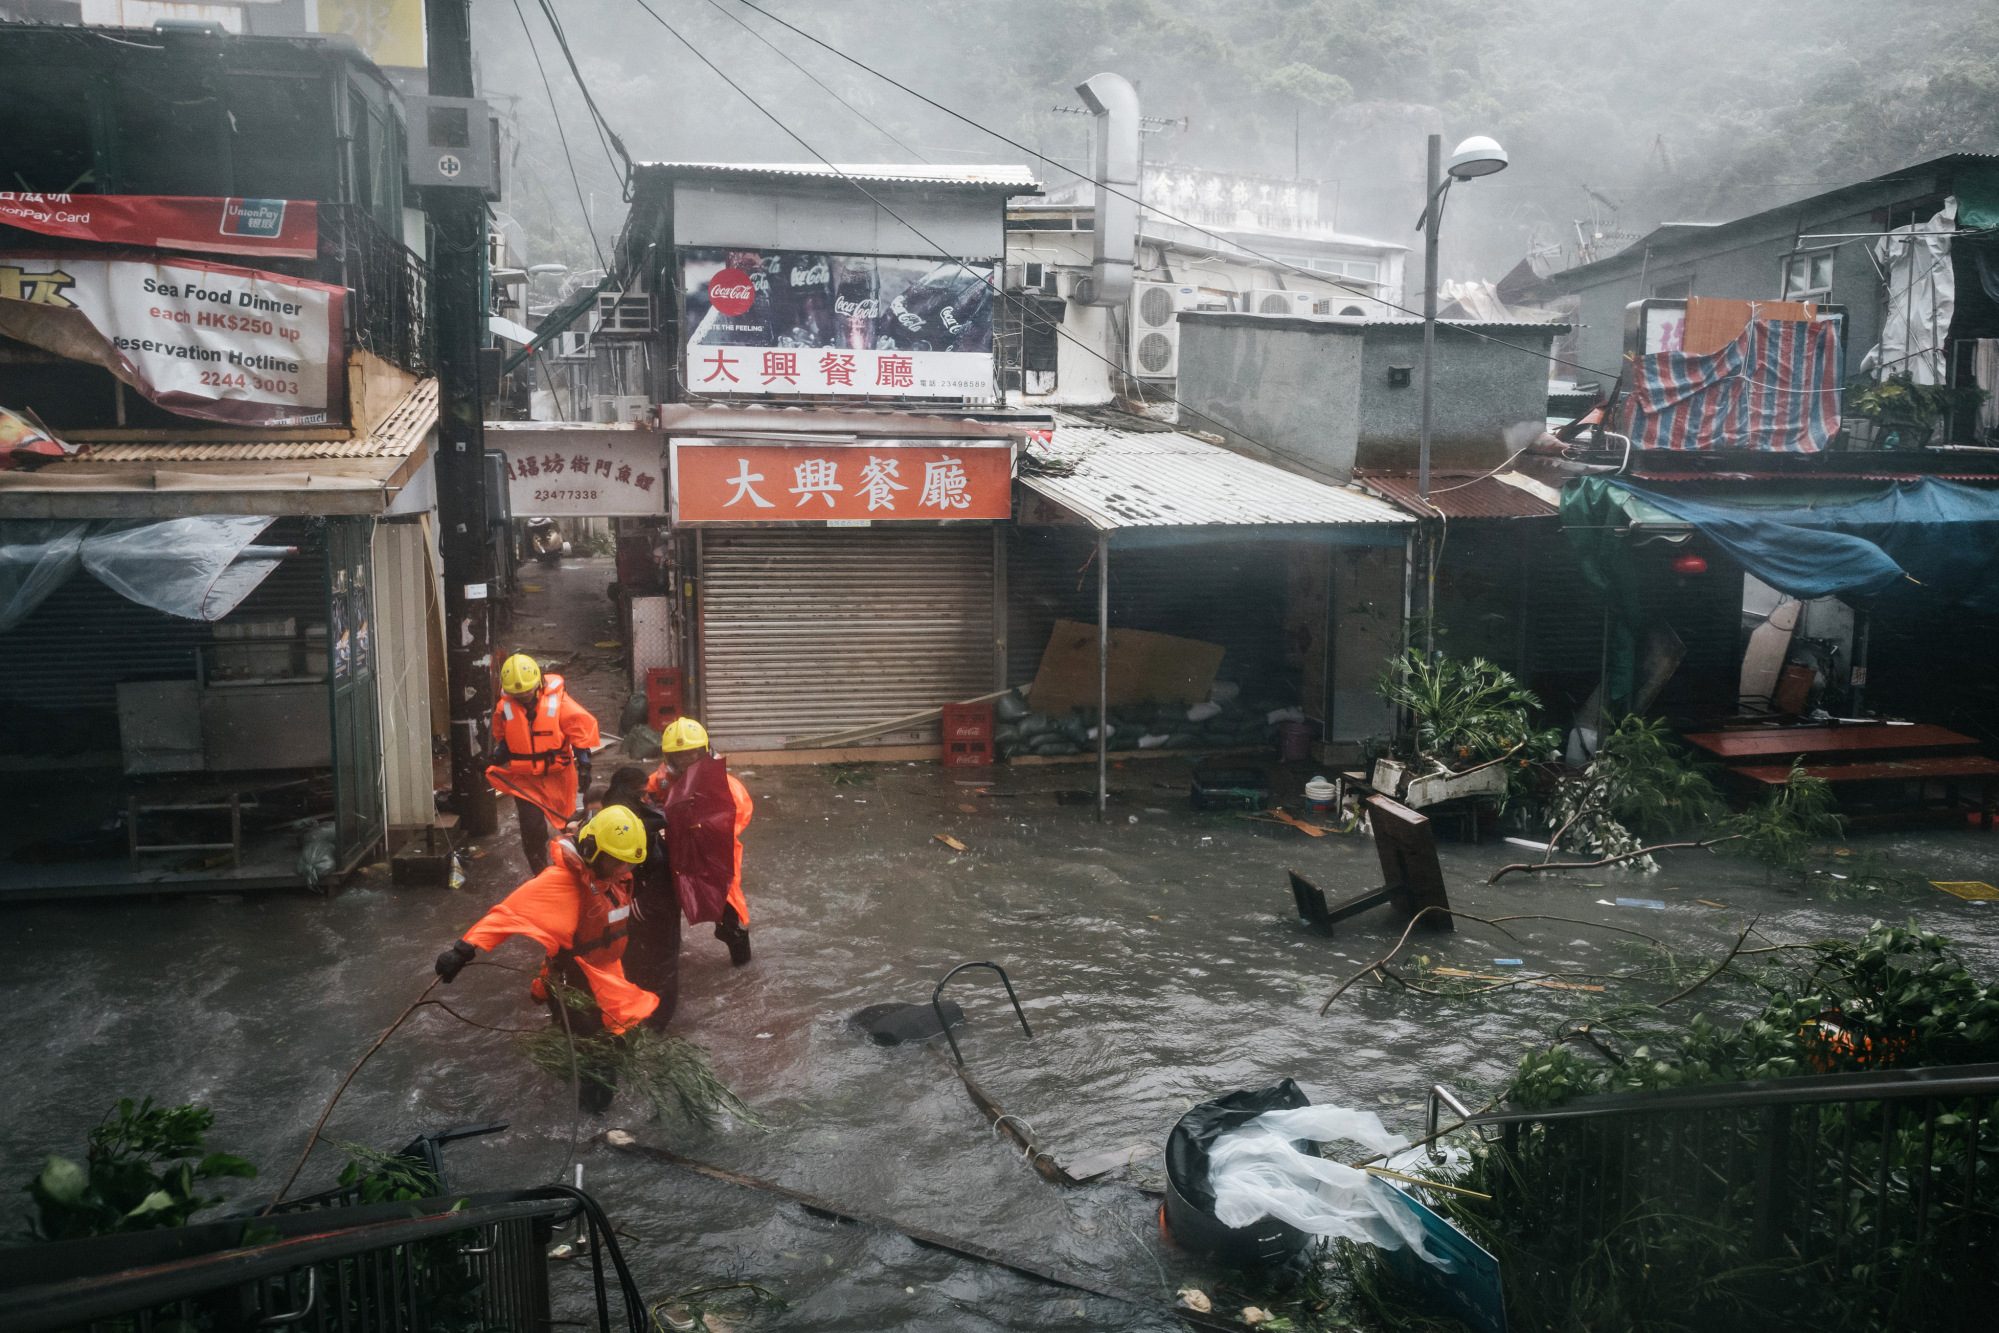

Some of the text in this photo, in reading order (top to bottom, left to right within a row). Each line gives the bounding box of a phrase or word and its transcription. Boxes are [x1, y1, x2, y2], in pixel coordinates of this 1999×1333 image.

[0, 206, 90, 223] ionPay Card
[229, 205, 279, 222] UnionPay
[143, 278, 302, 316] Sea Food Dinner
[150, 306, 300, 342] each HK$250 up
[735, 324, 763, 332] FEELING
[229, 350, 299, 374] Hotline
[703, 349, 914, 388] 大興餐廳
[200, 371, 299, 395] 2244 3003
[534, 490, 598, 500] 23477338
[722, 454, 972, 512] 大興餐廳
